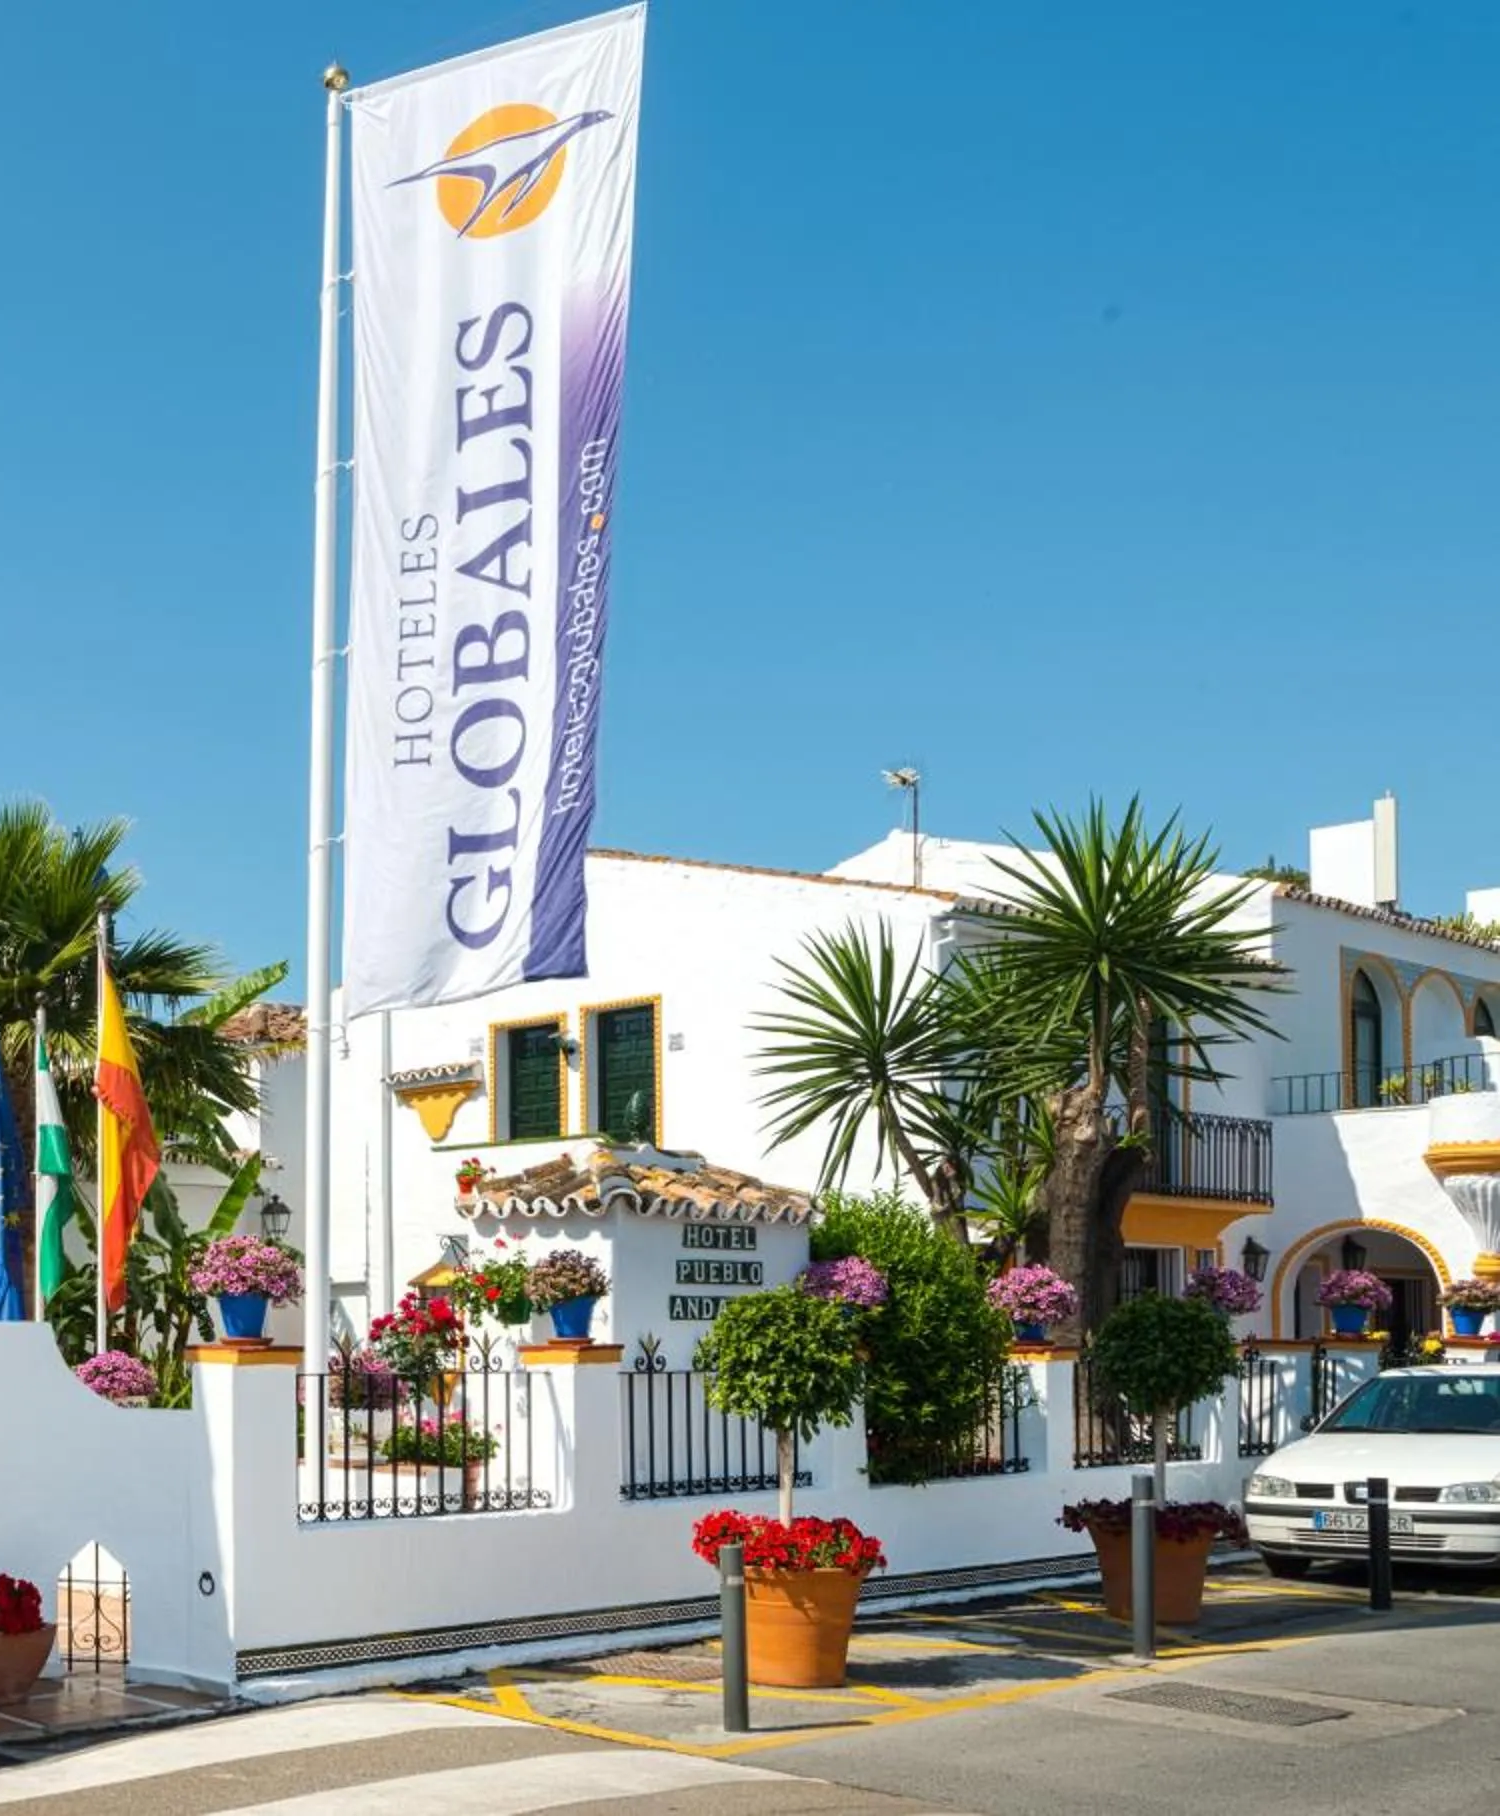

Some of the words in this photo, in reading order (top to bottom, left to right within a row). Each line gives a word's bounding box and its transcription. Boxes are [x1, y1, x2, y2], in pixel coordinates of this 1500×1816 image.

[446, 300, 534, 951] GLOBALES
[393, 510, 440, 768] HOTELES
[686, 1226, 756, 1249] HOTEL
[680, 1262, 761, 1284] PUEBLO
[672, 1297, 728, 1319] ANDA
